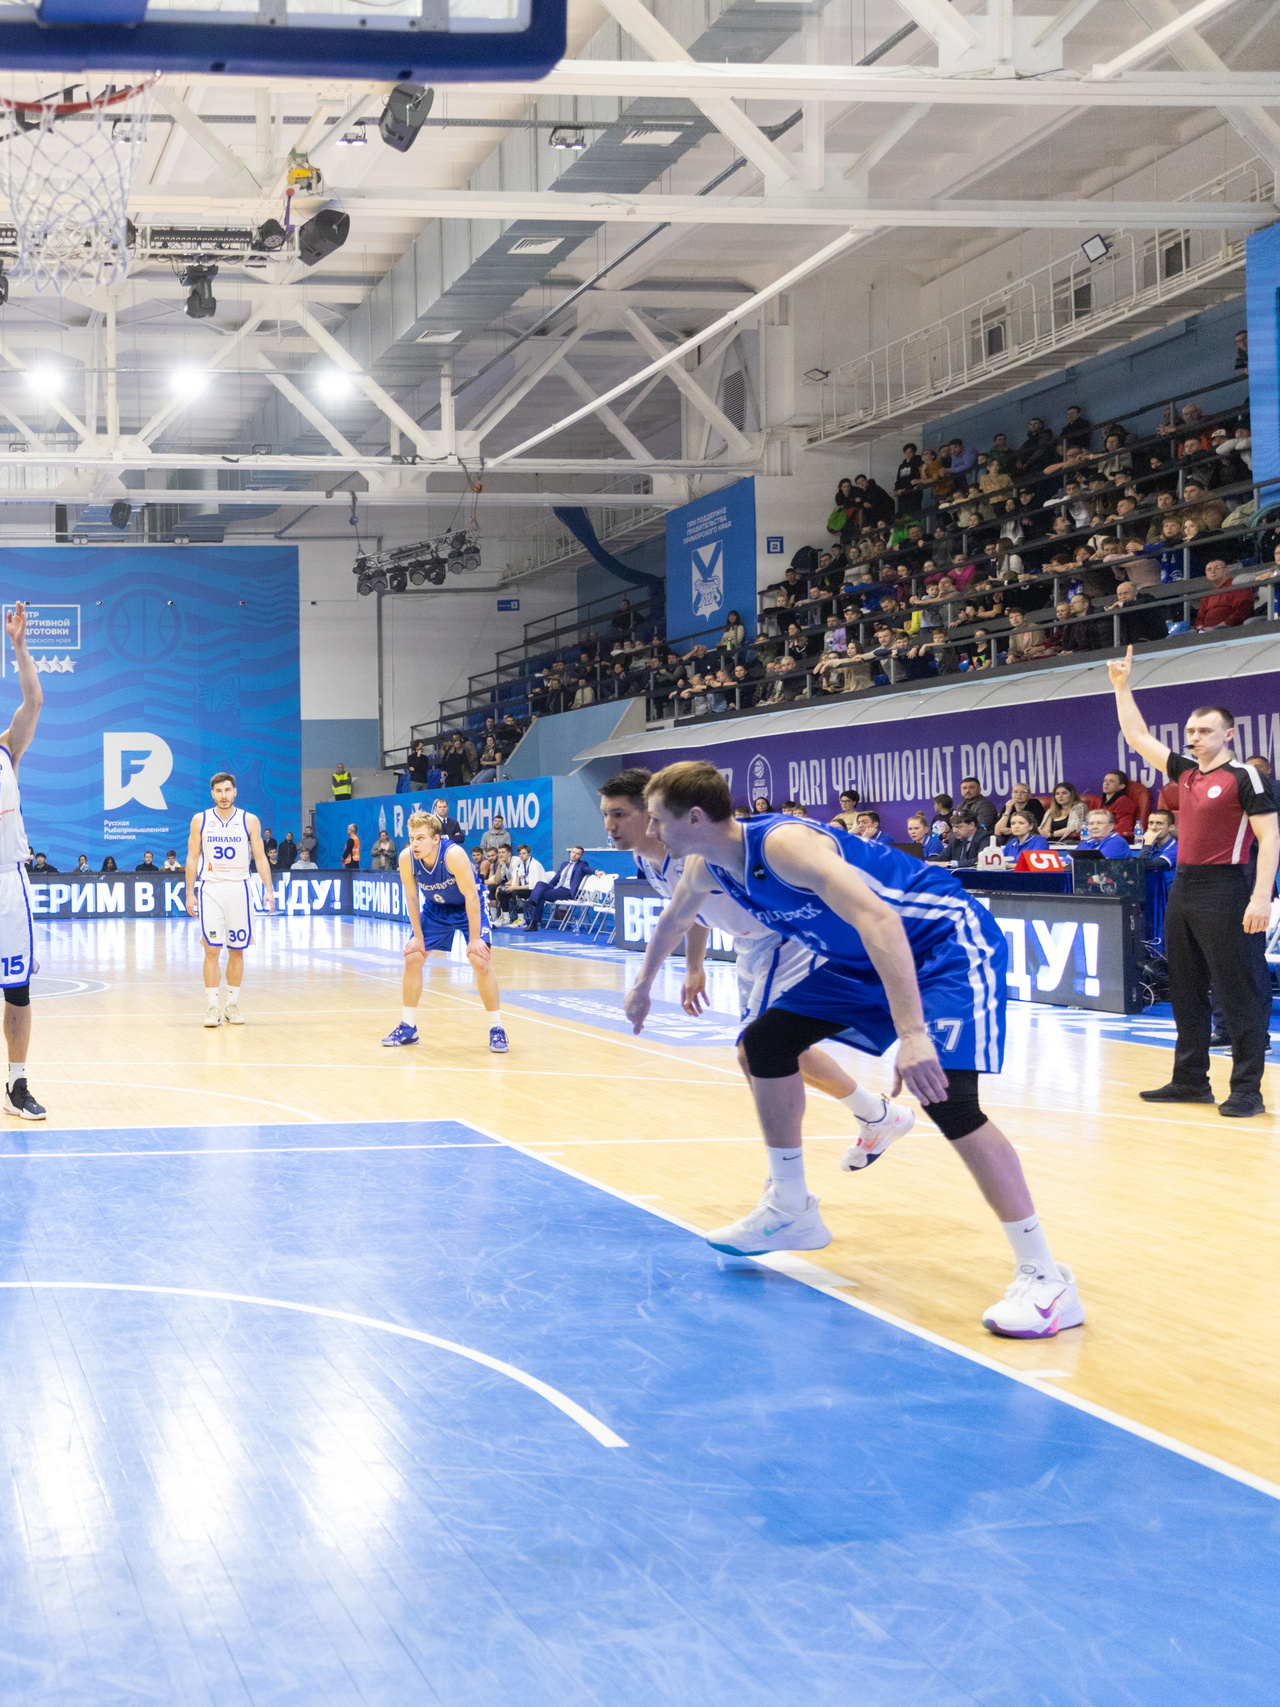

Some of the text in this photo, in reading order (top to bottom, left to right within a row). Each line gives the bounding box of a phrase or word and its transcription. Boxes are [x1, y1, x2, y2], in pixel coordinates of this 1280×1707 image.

[25, 618, 70, 627] ОРТИВНОЙ
[788, 757, 827, 807] PARI
[960, 735, 1064, 798] РОССИИ
[457, 792, 540, 836] ДИНАМО
[104, 820, 130, 828] Русская
[104, 826, 169, 834] Рыбопромышленная
[207, 835, 242, 843] ДИНАМО
[213, 846, 236, 860] 30
[985, 853, 1001, 866] 5
[1029, 853, 1059, 870] 5
[31, 882, 125, 913] ЕРИМ
[134, 882, 155, 912] В
[353, 879, 391, 914] ВЕРИМ
[229, 929, 247, 942] 30
[1, 954, 25, 977] 15
